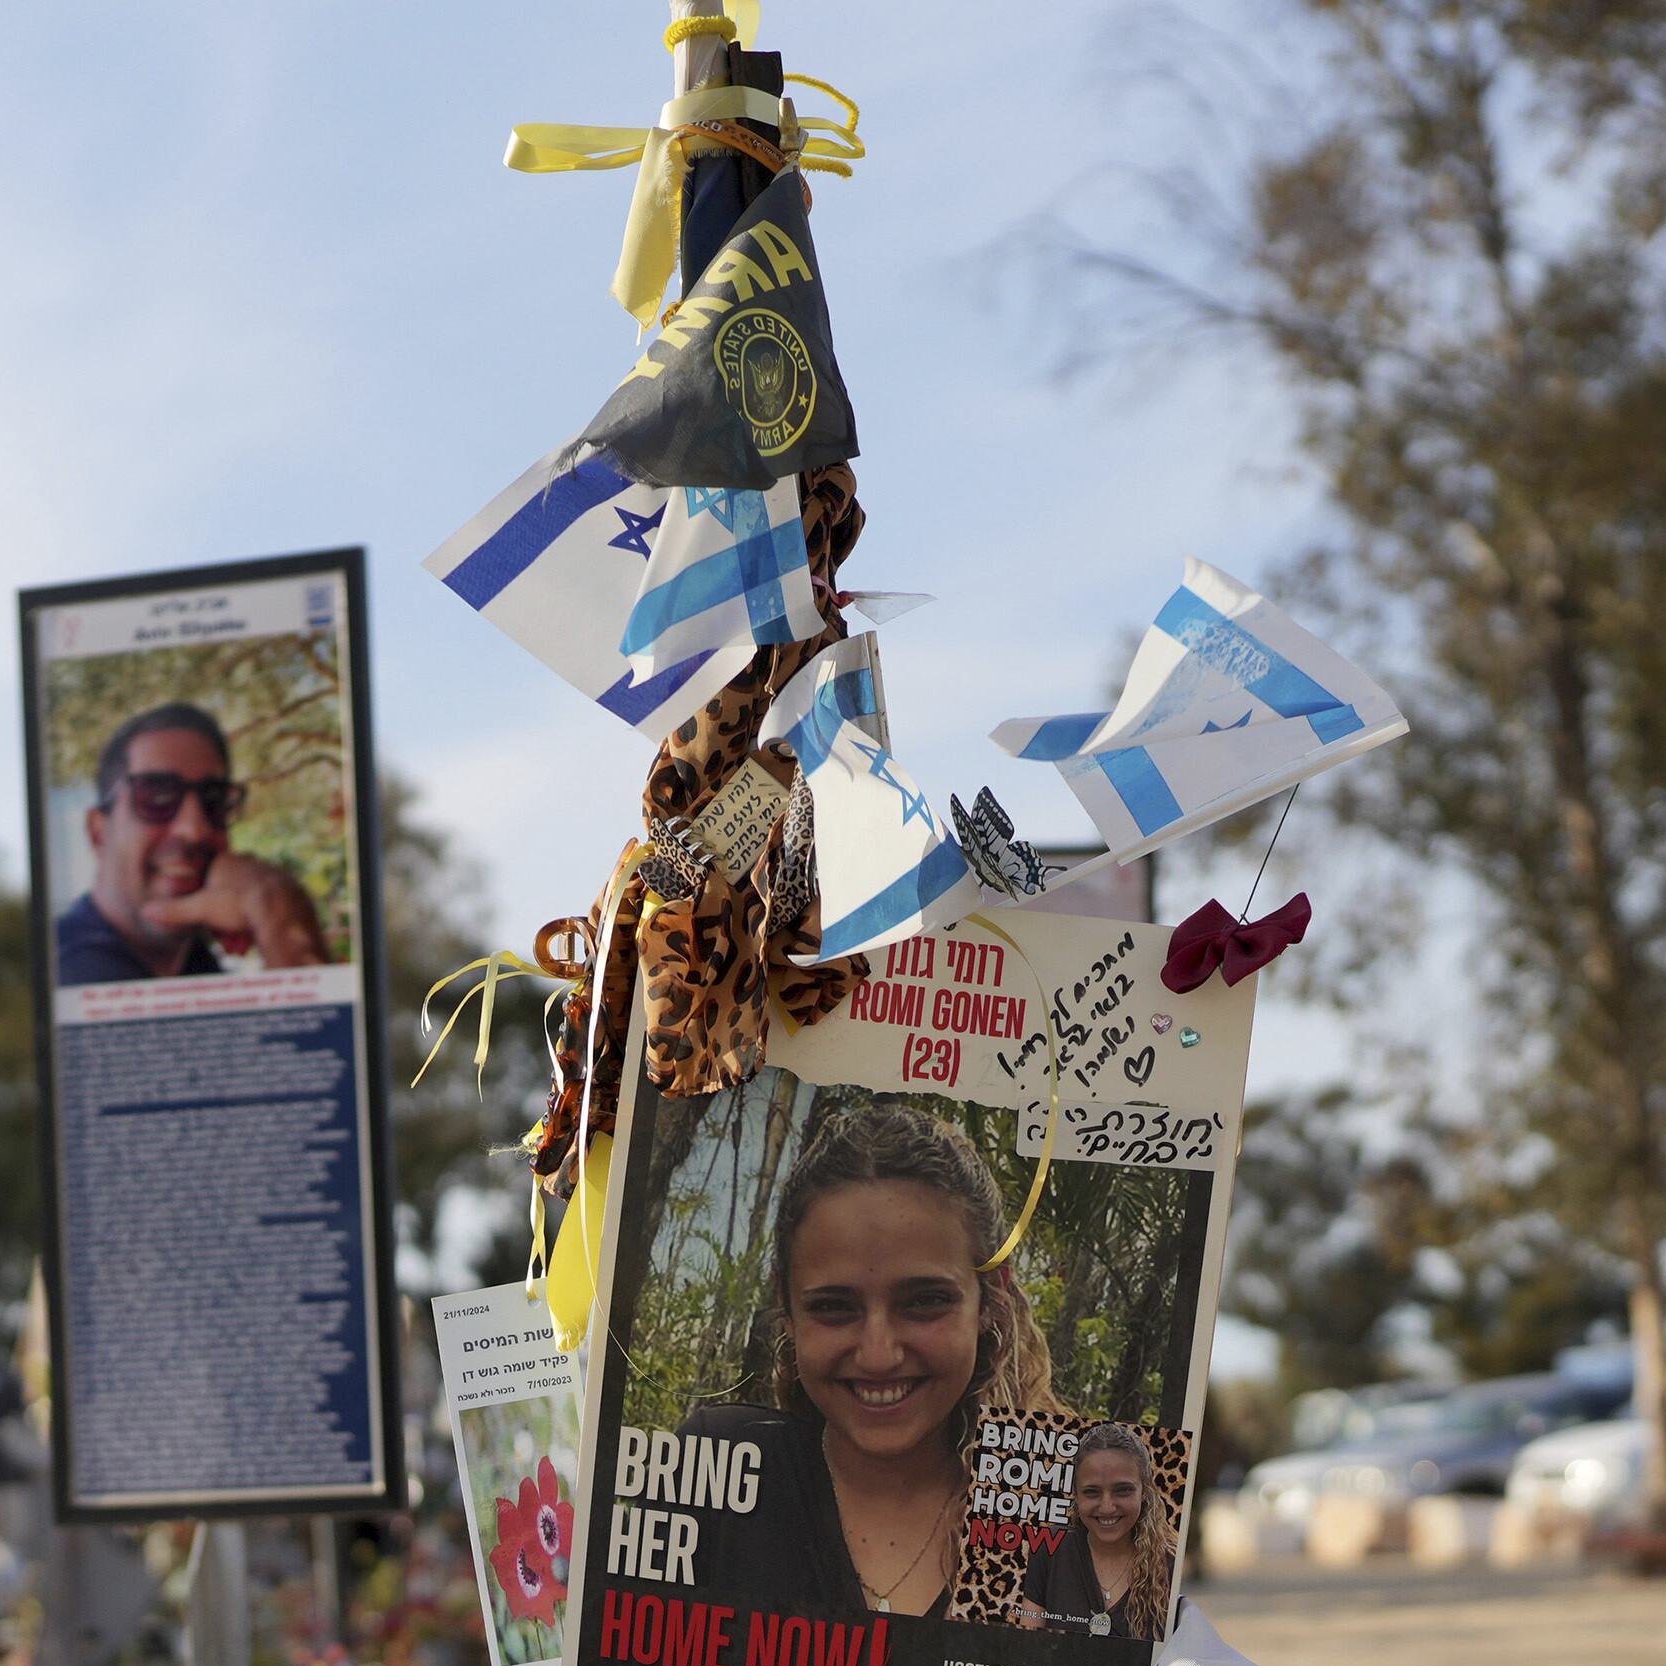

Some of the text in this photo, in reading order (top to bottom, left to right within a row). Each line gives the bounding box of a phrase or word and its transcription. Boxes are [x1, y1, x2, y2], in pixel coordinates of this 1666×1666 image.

[885, 936, 1005, 987] רומי גונן
[849, 980, 1027, 1040] ROMI GONEN
[902, 1033, 961, 1088] (23)
[443, 1305, 490, 1319] 21/11/2024
[463, 1327, 554, 1352] שות המיסים
[462, 1354, 569, 1384] פקיד שומה גוש דן
[527, 1376, 573, 1390] 7/10/2023
[480, 1389, 494, 1398] ולא
[981, 1422, 1080, 1458] BRING
[614, 1425, 762, 1514] BRING
[977, 1453, 1075, 1494] ROMI
[972, 1487, 1072, 1525] HOME
[607, 1503, 700, 1586] HER
[969, 1518, 1067, 1557] NOW
